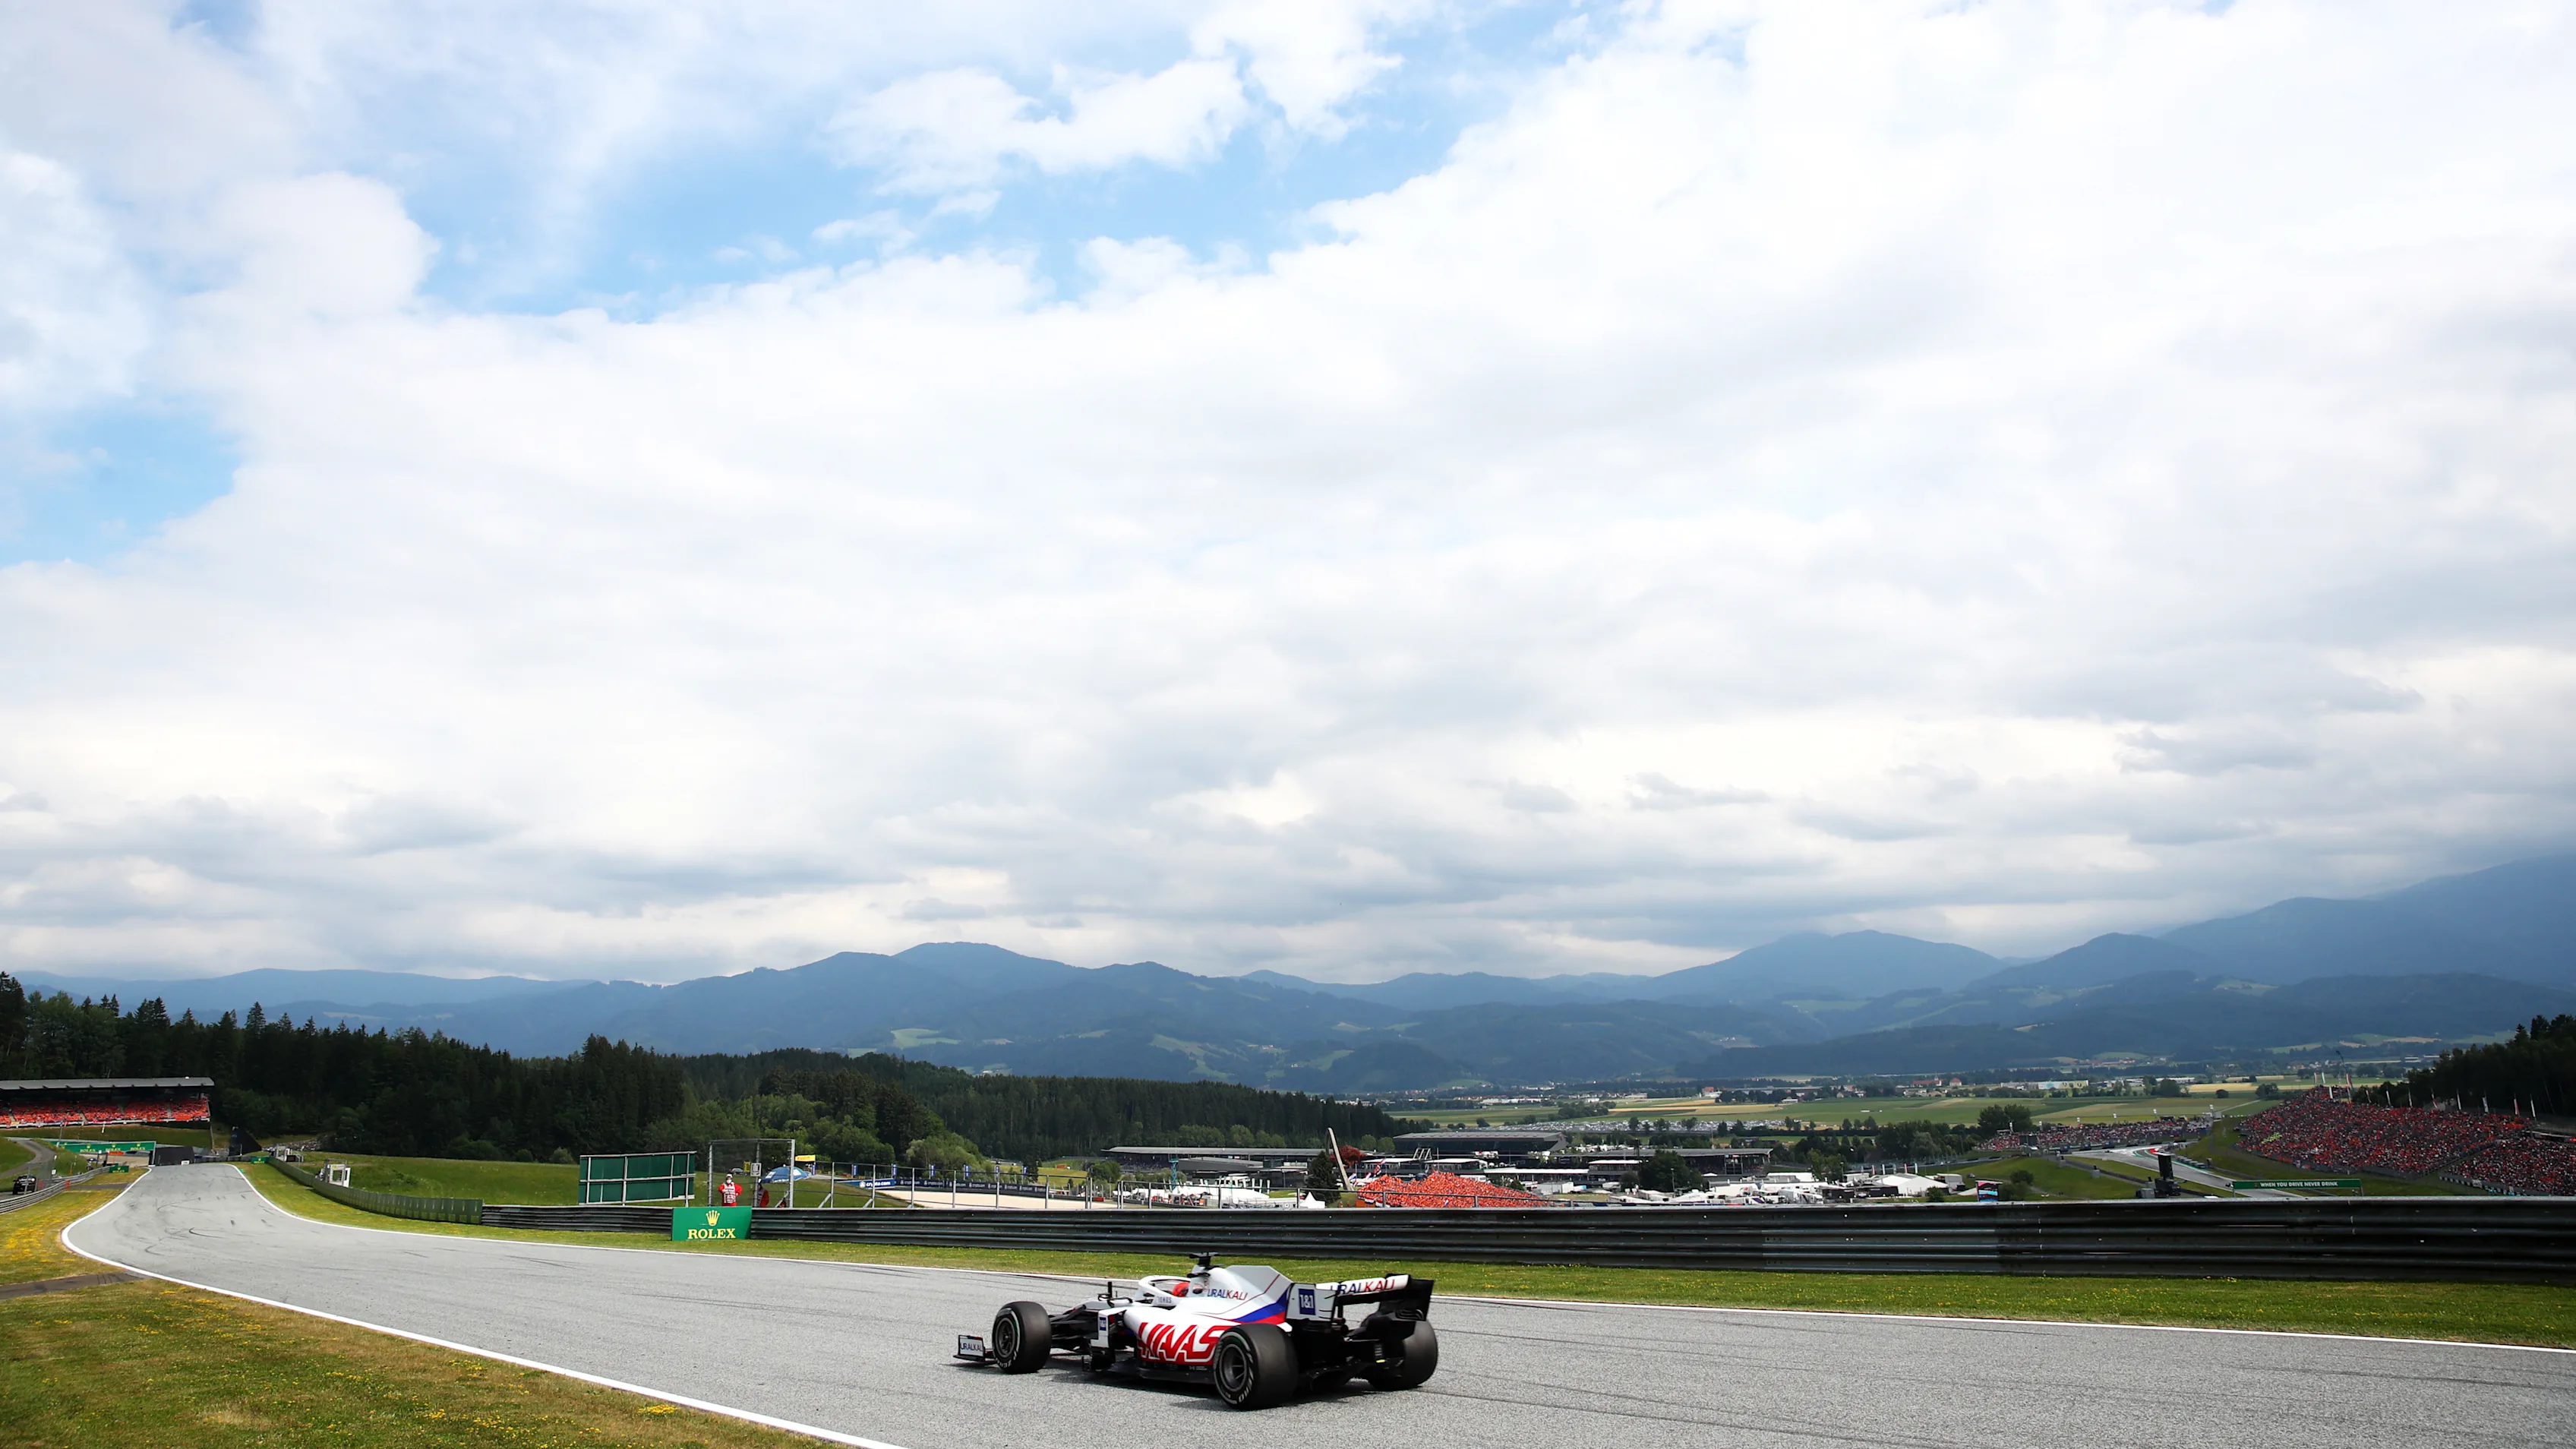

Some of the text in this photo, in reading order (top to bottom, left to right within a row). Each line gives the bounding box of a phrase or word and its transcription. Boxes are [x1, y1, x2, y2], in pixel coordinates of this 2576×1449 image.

[688, 1228, 736, 1239] ROLEX
[1299, 1294, 1314, 1308] 1&1
[1138, 1322, 1234, 1362] HAAS
